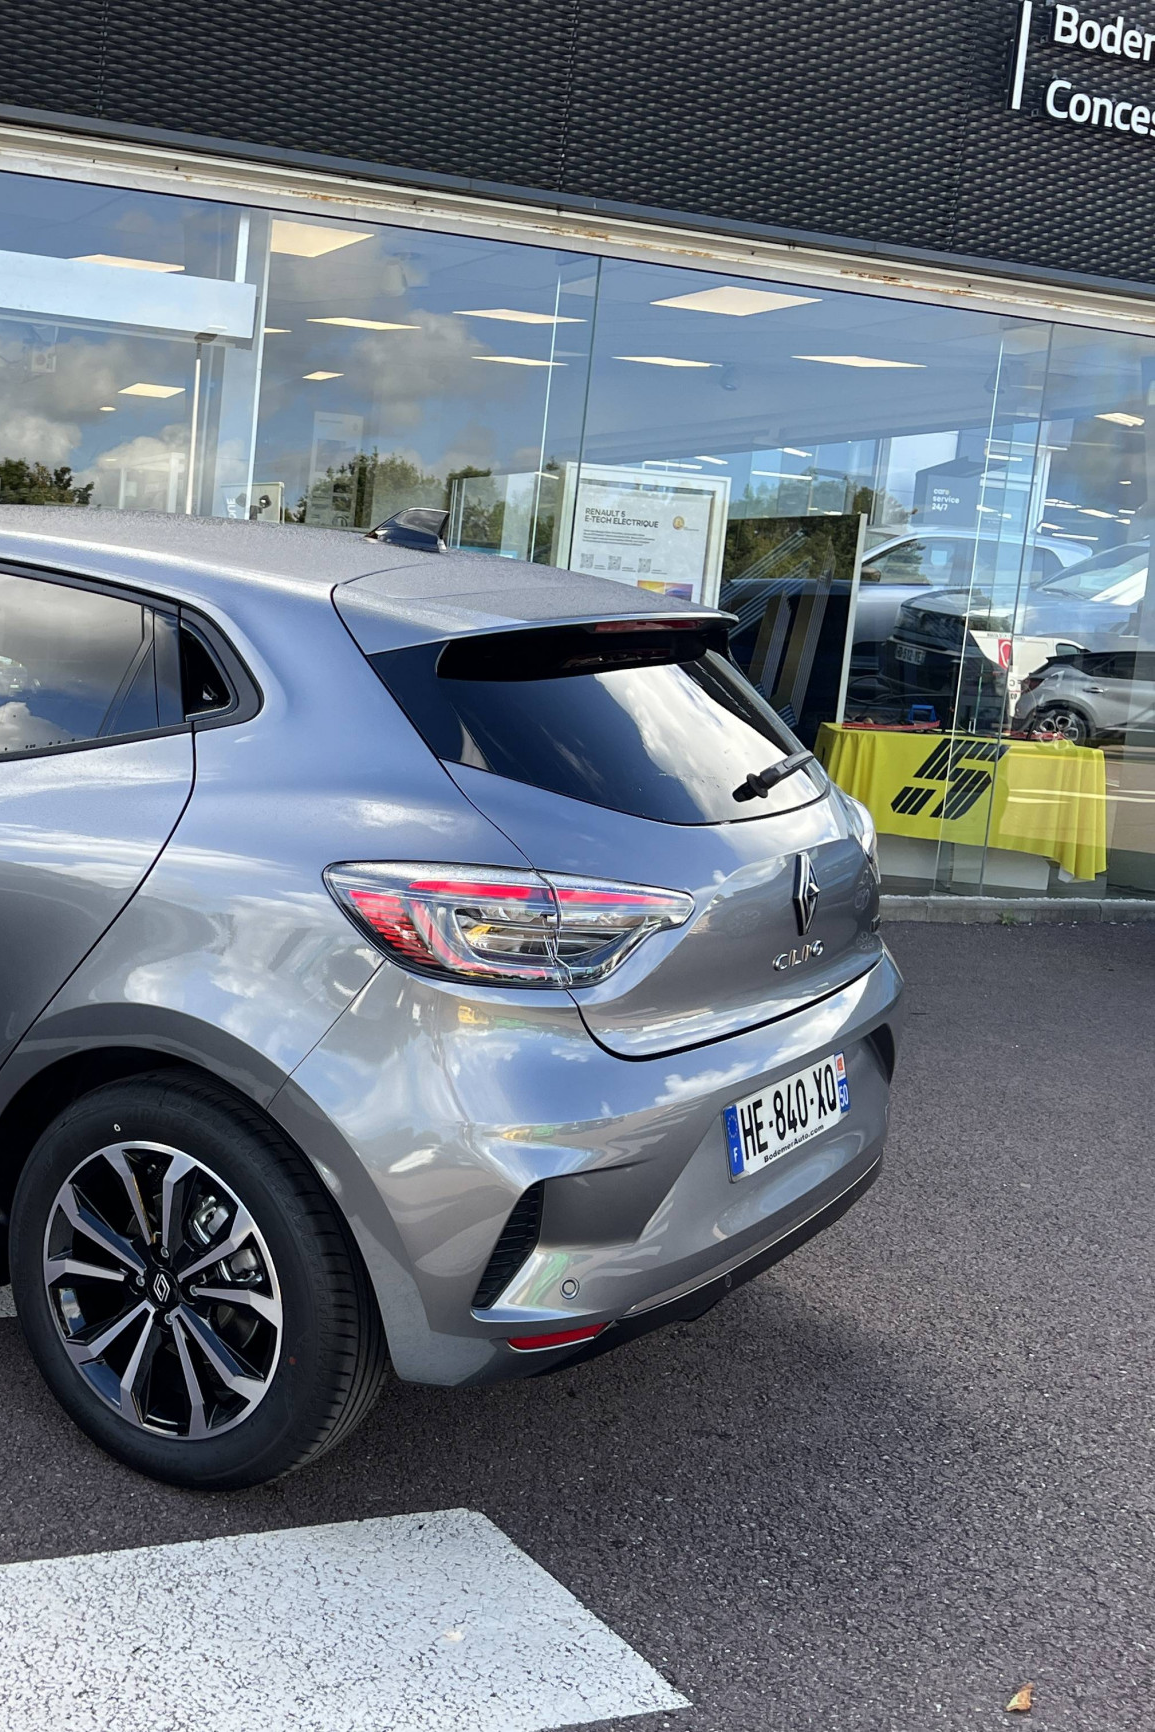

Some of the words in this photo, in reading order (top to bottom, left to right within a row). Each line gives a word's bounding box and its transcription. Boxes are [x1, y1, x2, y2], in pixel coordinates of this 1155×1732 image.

[1046, 79, 1155, 137] Conce
[931, 502, 948, 511] 24/7
[932, 495, 960, 504] service
[584, 516, 612, 525] E-TECH
[585, 508, 620, 518] RENAULT
[620, 510, 626, 518] 5
[772, 939, 825, 972] CLIO
[839, 1083, 849, 1107] 50
[740, 1063, 837, 1161] HE-840-XQ
[763, 1124, 825, 1163] BodemerAuto.com
[733, 1146, 739, 1163] F
